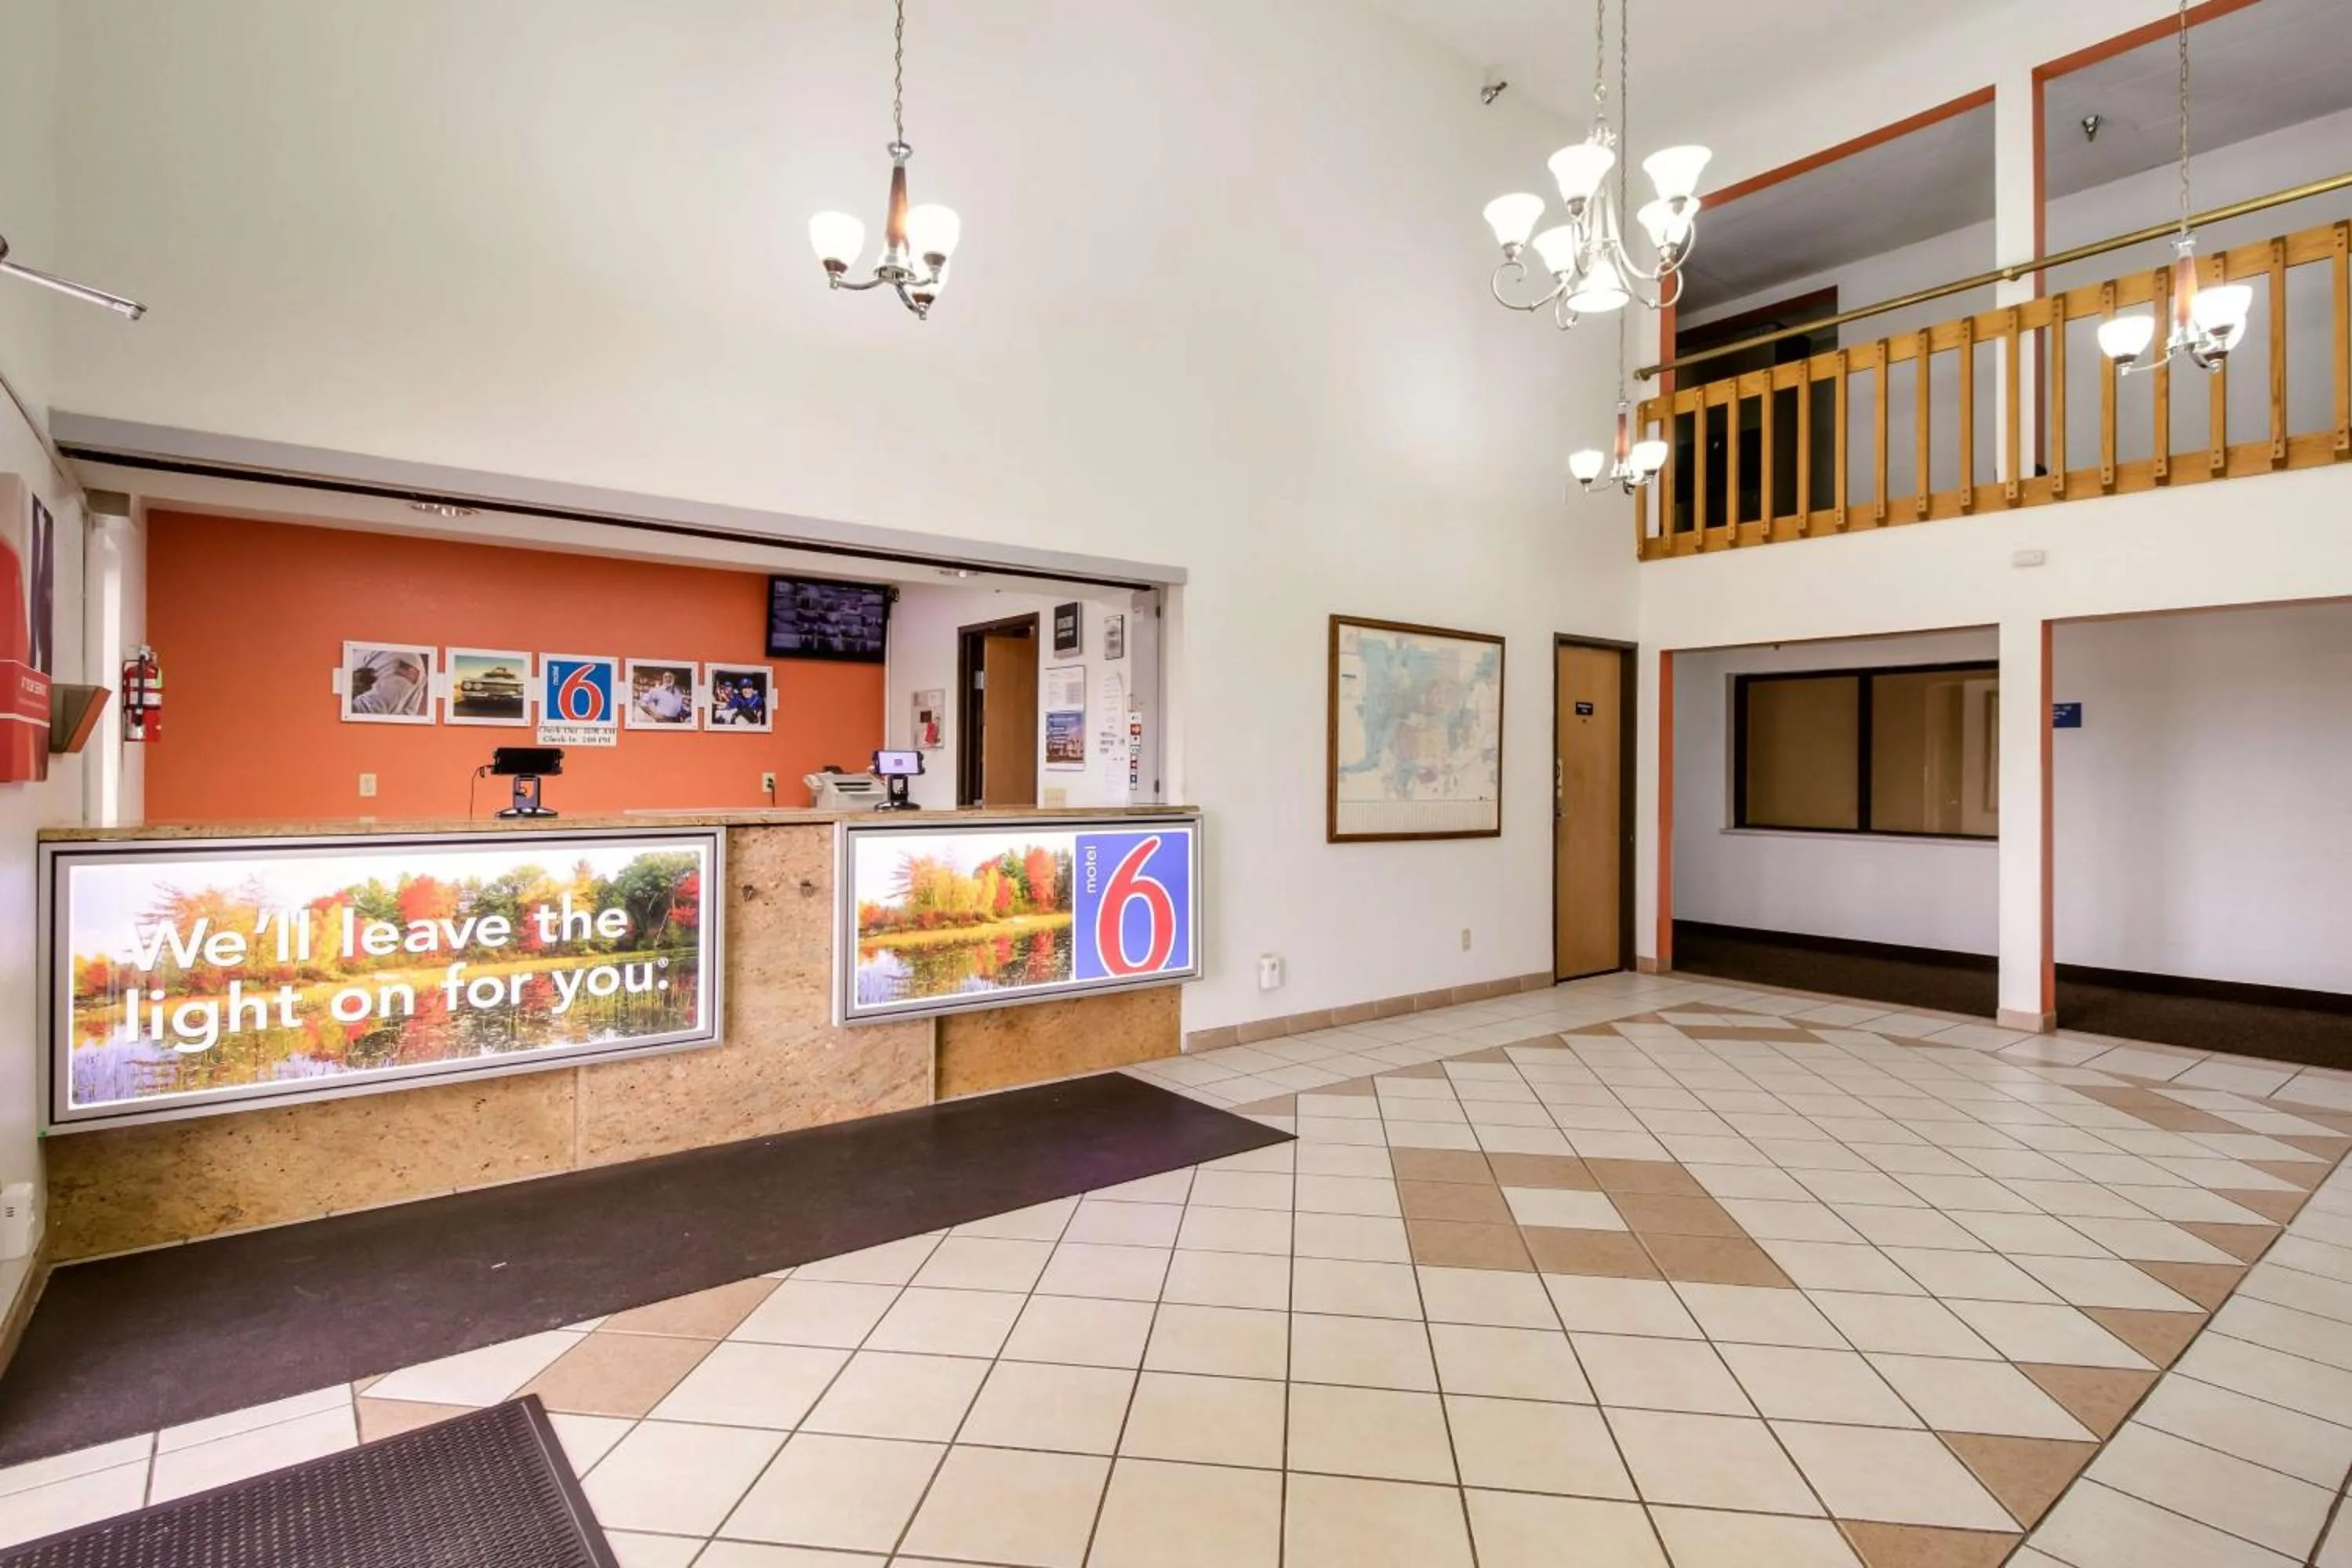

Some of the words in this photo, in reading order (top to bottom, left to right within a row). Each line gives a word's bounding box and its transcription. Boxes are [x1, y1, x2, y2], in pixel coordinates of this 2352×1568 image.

[557, 662, 604, 721] 6
[342, 906, 510, 957] leave
[533, 891, 628, 943] the
[1084, 846, 1097, 894] motel
[1095, 835, 1176, 977] 6
[125, 979, 303, 1053] light
[330, 982, 416, 1022] on
[441, 961, 533, 1011] for
